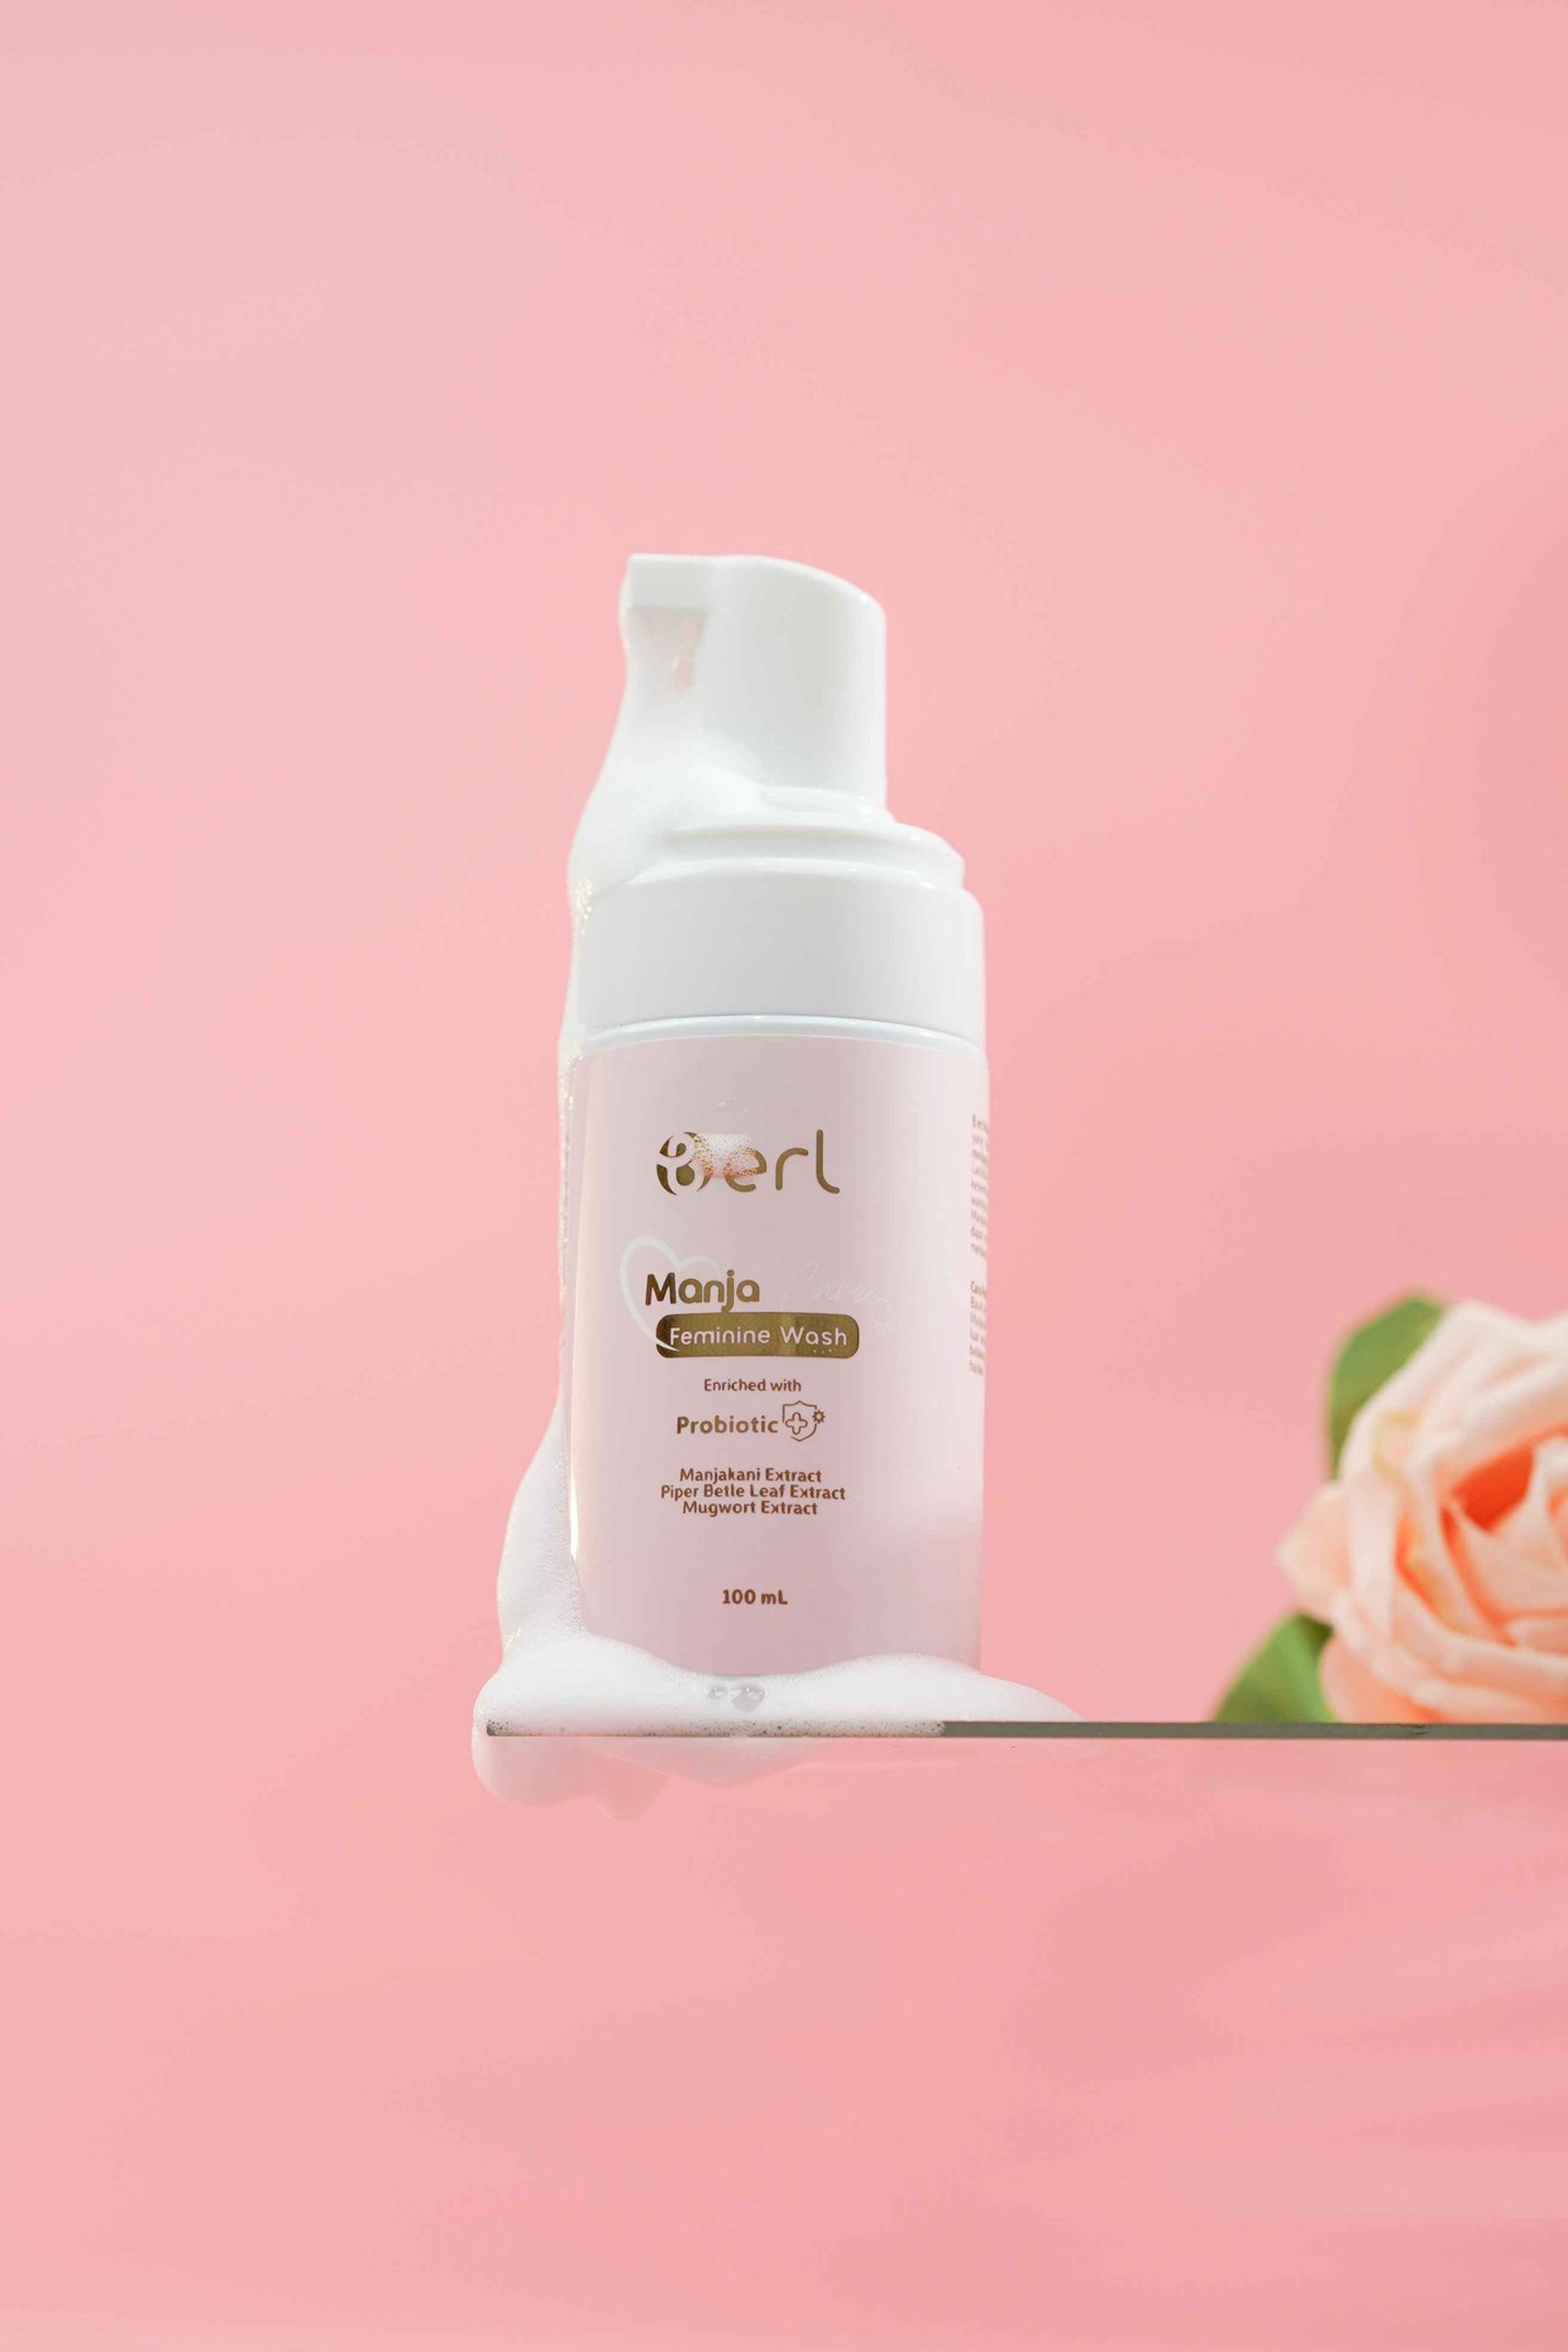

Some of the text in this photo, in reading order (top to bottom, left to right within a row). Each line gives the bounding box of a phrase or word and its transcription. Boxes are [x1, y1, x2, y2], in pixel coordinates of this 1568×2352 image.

[644, 1269, 760, 1314] Manja
[670, 1326, 848, 1347] Feminine Wash
[704, 1379, 802, 1392] Enriched with
[676, 1415, 778, 1434] Probiotic
[679, 1468, 822, 1485] Manjakani Extract
[661, 1484, 846, 1501] Piper Betle Leaf Extract
[683, 1501, 818, 1517] Mugwort Extract
[722, 1589, 789, 1606] 100 mL
